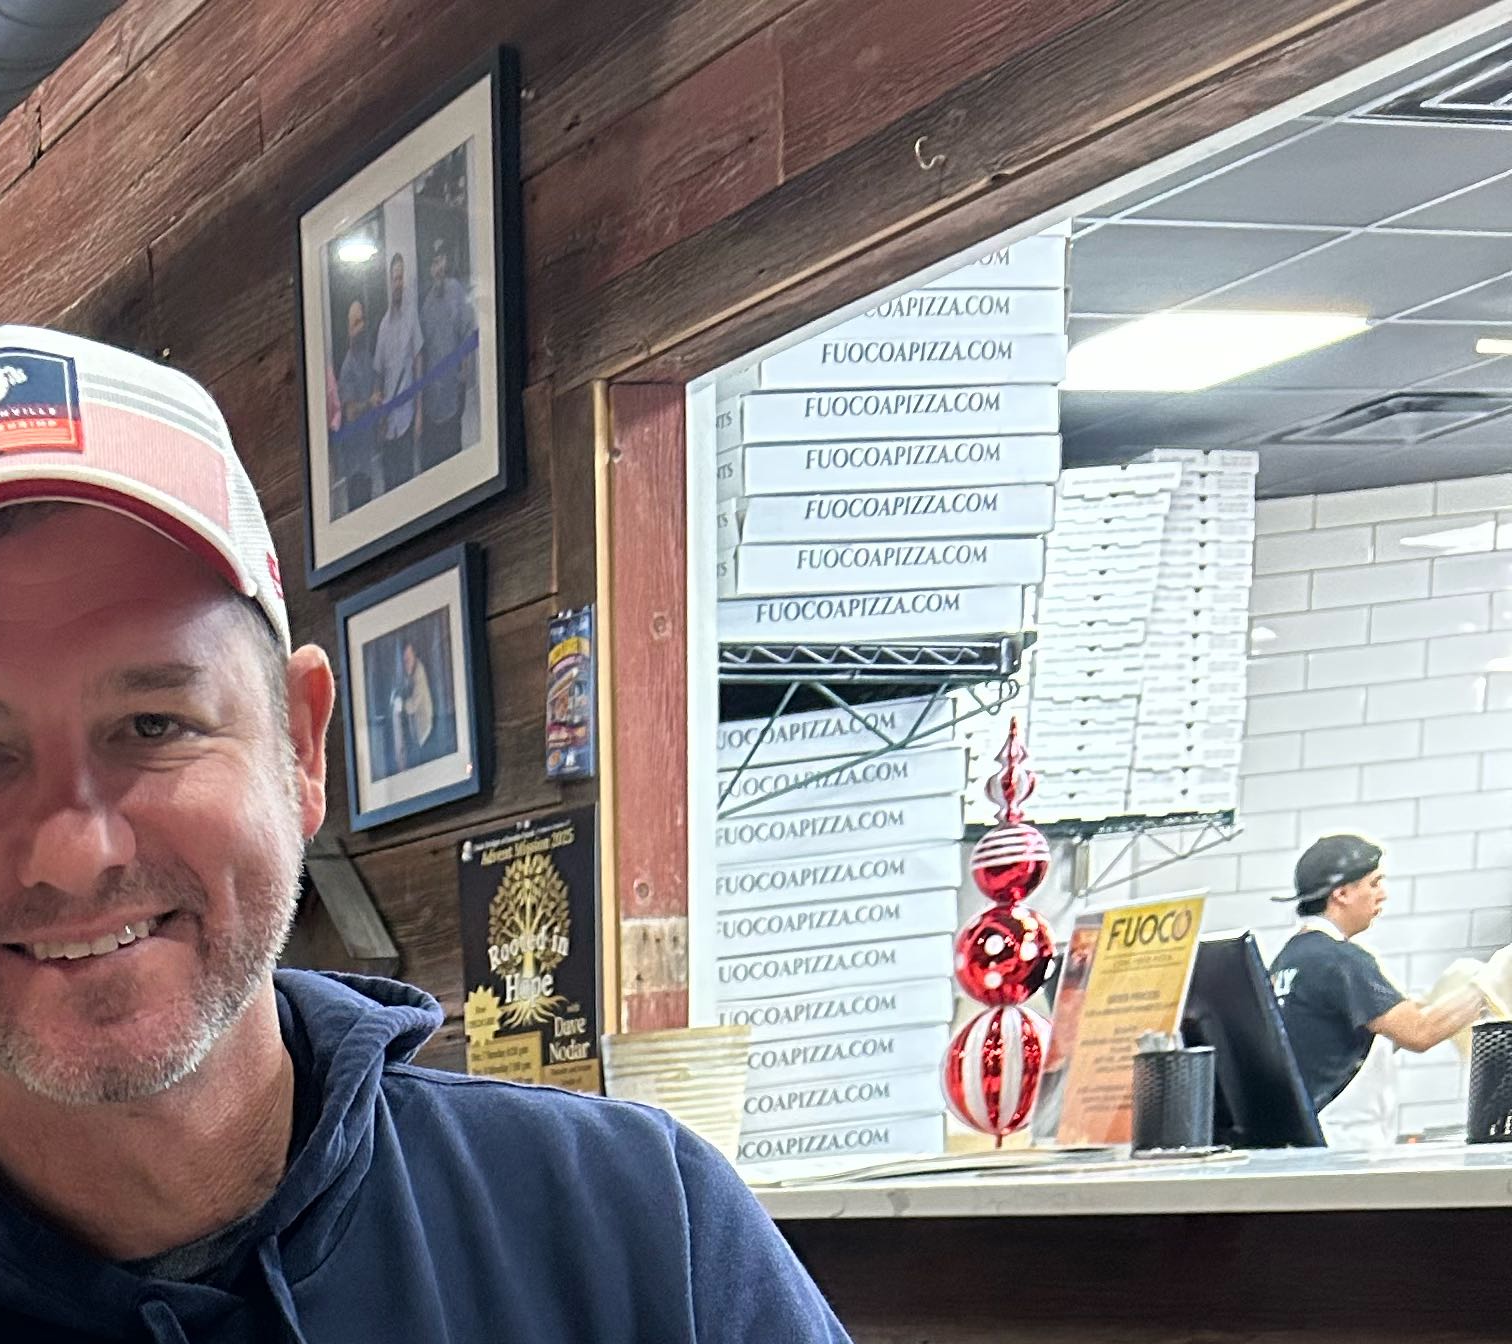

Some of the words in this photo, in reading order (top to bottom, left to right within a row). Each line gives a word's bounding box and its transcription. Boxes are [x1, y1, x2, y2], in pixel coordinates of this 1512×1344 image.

[863, 294, 1010, 318] COAPIZZA.COM
[821, 340, 1013, 364] FUOCOAPIZZA.COM
[804, 391, 1001, 418] FUOCOAPIZZA.COM
[805, 442, 1001, 470] FUOCOAPIZZA.COM
[804, 492, 999, 520] FUOCOAPIZZA.COM
[796, 544, 988, 570] FUOCOAPIZZA.COM
[755, 592, 961, 623] FUOCOAPIZZA.COM
[717, 711, 897, 750] UOCOAPIZZA.COM
[717, 903, 901, 940] UOCOAPIZZA.COM
[1106, 908, 1193, 951] FUOCO
[488, 923, 548, 972] Rooted
[551, 925, 570, 957] in
[718, 948, 897, 984] UOCOAPIZZA.COM
[505, 973, 555, 1004] Hope
[719, 994, 897, 1027] UOCOAPIZZA.COM
[554, 1016, 587, 1038] Dave
[549, 1039, 591, 1063] Nodar
[746, 1038, 895, 1071] COAPIZZA.COM
[743, 1082, 891, 1116] COAPIZZA.COM
[736, 1127, 890, 1161] COAPIZZA.COM
